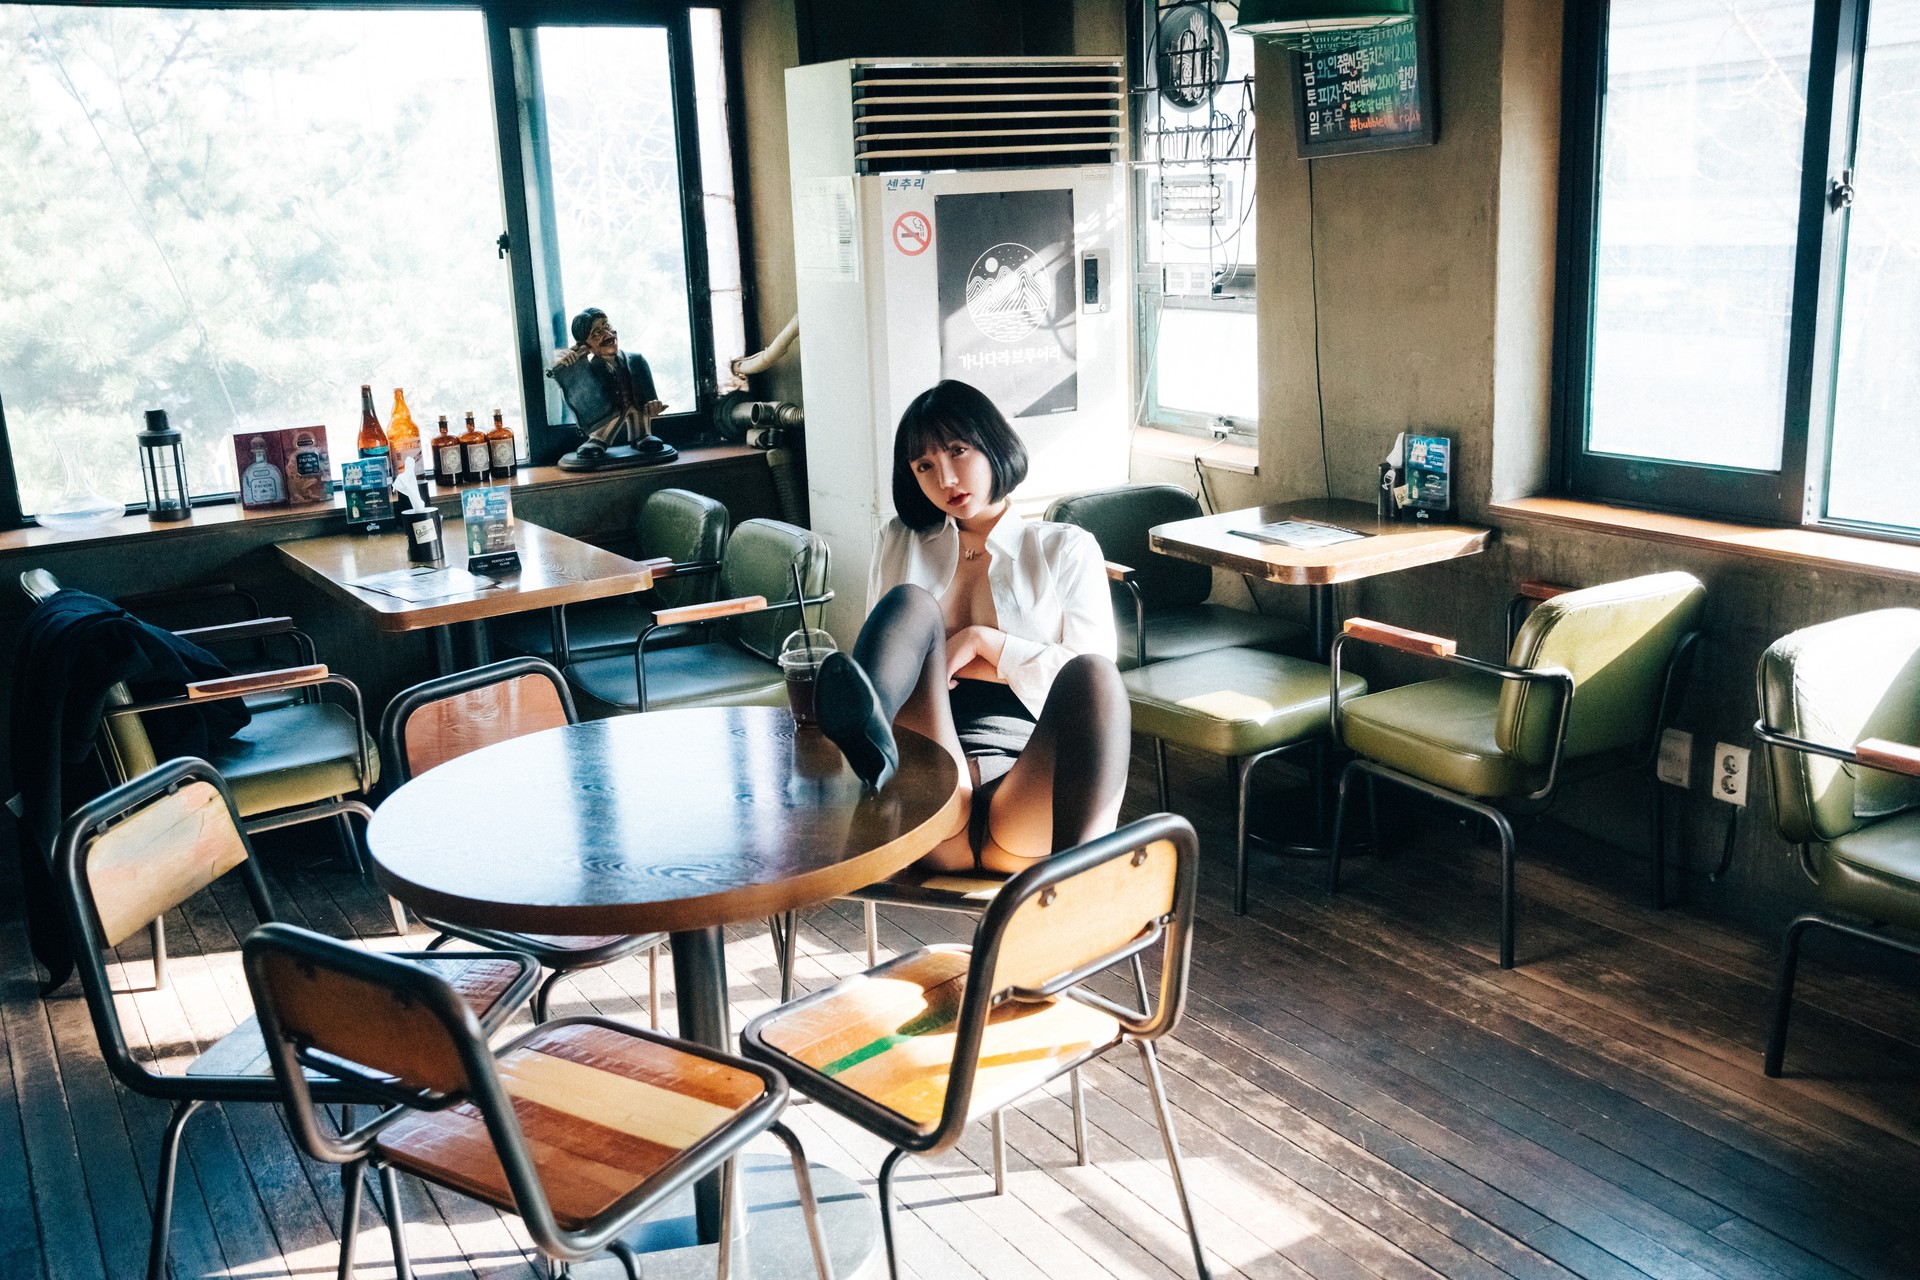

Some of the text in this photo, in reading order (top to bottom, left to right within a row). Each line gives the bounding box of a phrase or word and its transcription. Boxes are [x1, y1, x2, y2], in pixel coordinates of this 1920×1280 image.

[1303, 62, 1316, 87] 금
[1317, 55, 1338, 78] 와인
[1306, 88, 1318, 107] 토
[1317, 83, 1342, 105] 피자
[1309, 111, 1321, 136] 일
[1321, 107, 1345, 134] 휴무
[886, 177, 926, 191] 센추리
